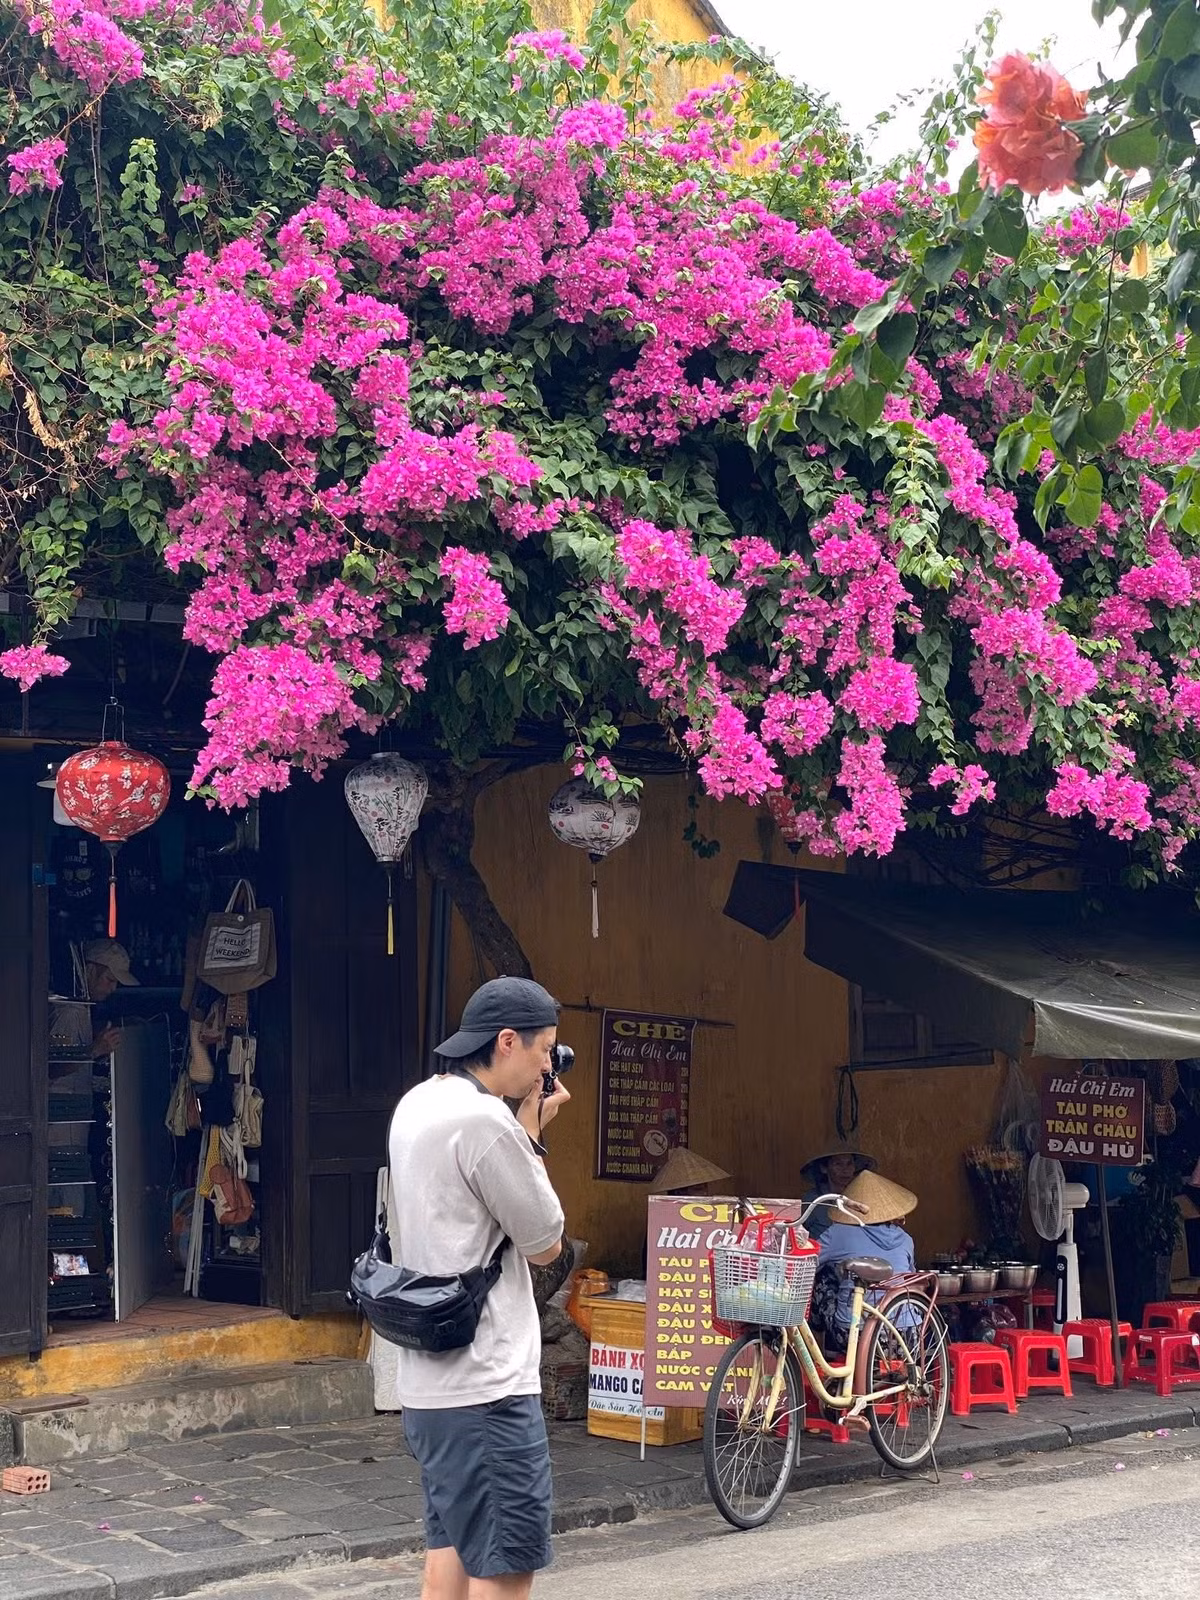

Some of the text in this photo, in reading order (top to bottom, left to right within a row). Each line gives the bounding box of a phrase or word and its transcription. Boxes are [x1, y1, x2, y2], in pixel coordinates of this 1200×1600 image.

[223, 937, 246, 946] HELLO
[215, 948, 250, 957] WEEKEND
[610, 1039, 687, 1063] Hai Chị Em
[1050, 1078, 1135, 1099] Hai Chị Em
[1046, 1118, 1137, 1139] TRÂN CHÂU
[1047, 1137, 1095, 1156] ĐẬU
[656, 1226, 702, 1249] Hai
[658, 1270, 696, 1284] ĐẬU
[658, 1287, 693, 1300] HẠT
[657, 1302, 696, 1315] ĐẬU
[656, 1317, 695, 1330] ĐẬU
[656, 1332, 695, 1346] ĐẬU
[591, 1344, 627, 1369] BÁNH
[589, 1373, 628, 1393] MANGO
[655, 1380, 694, 1391] CAM
